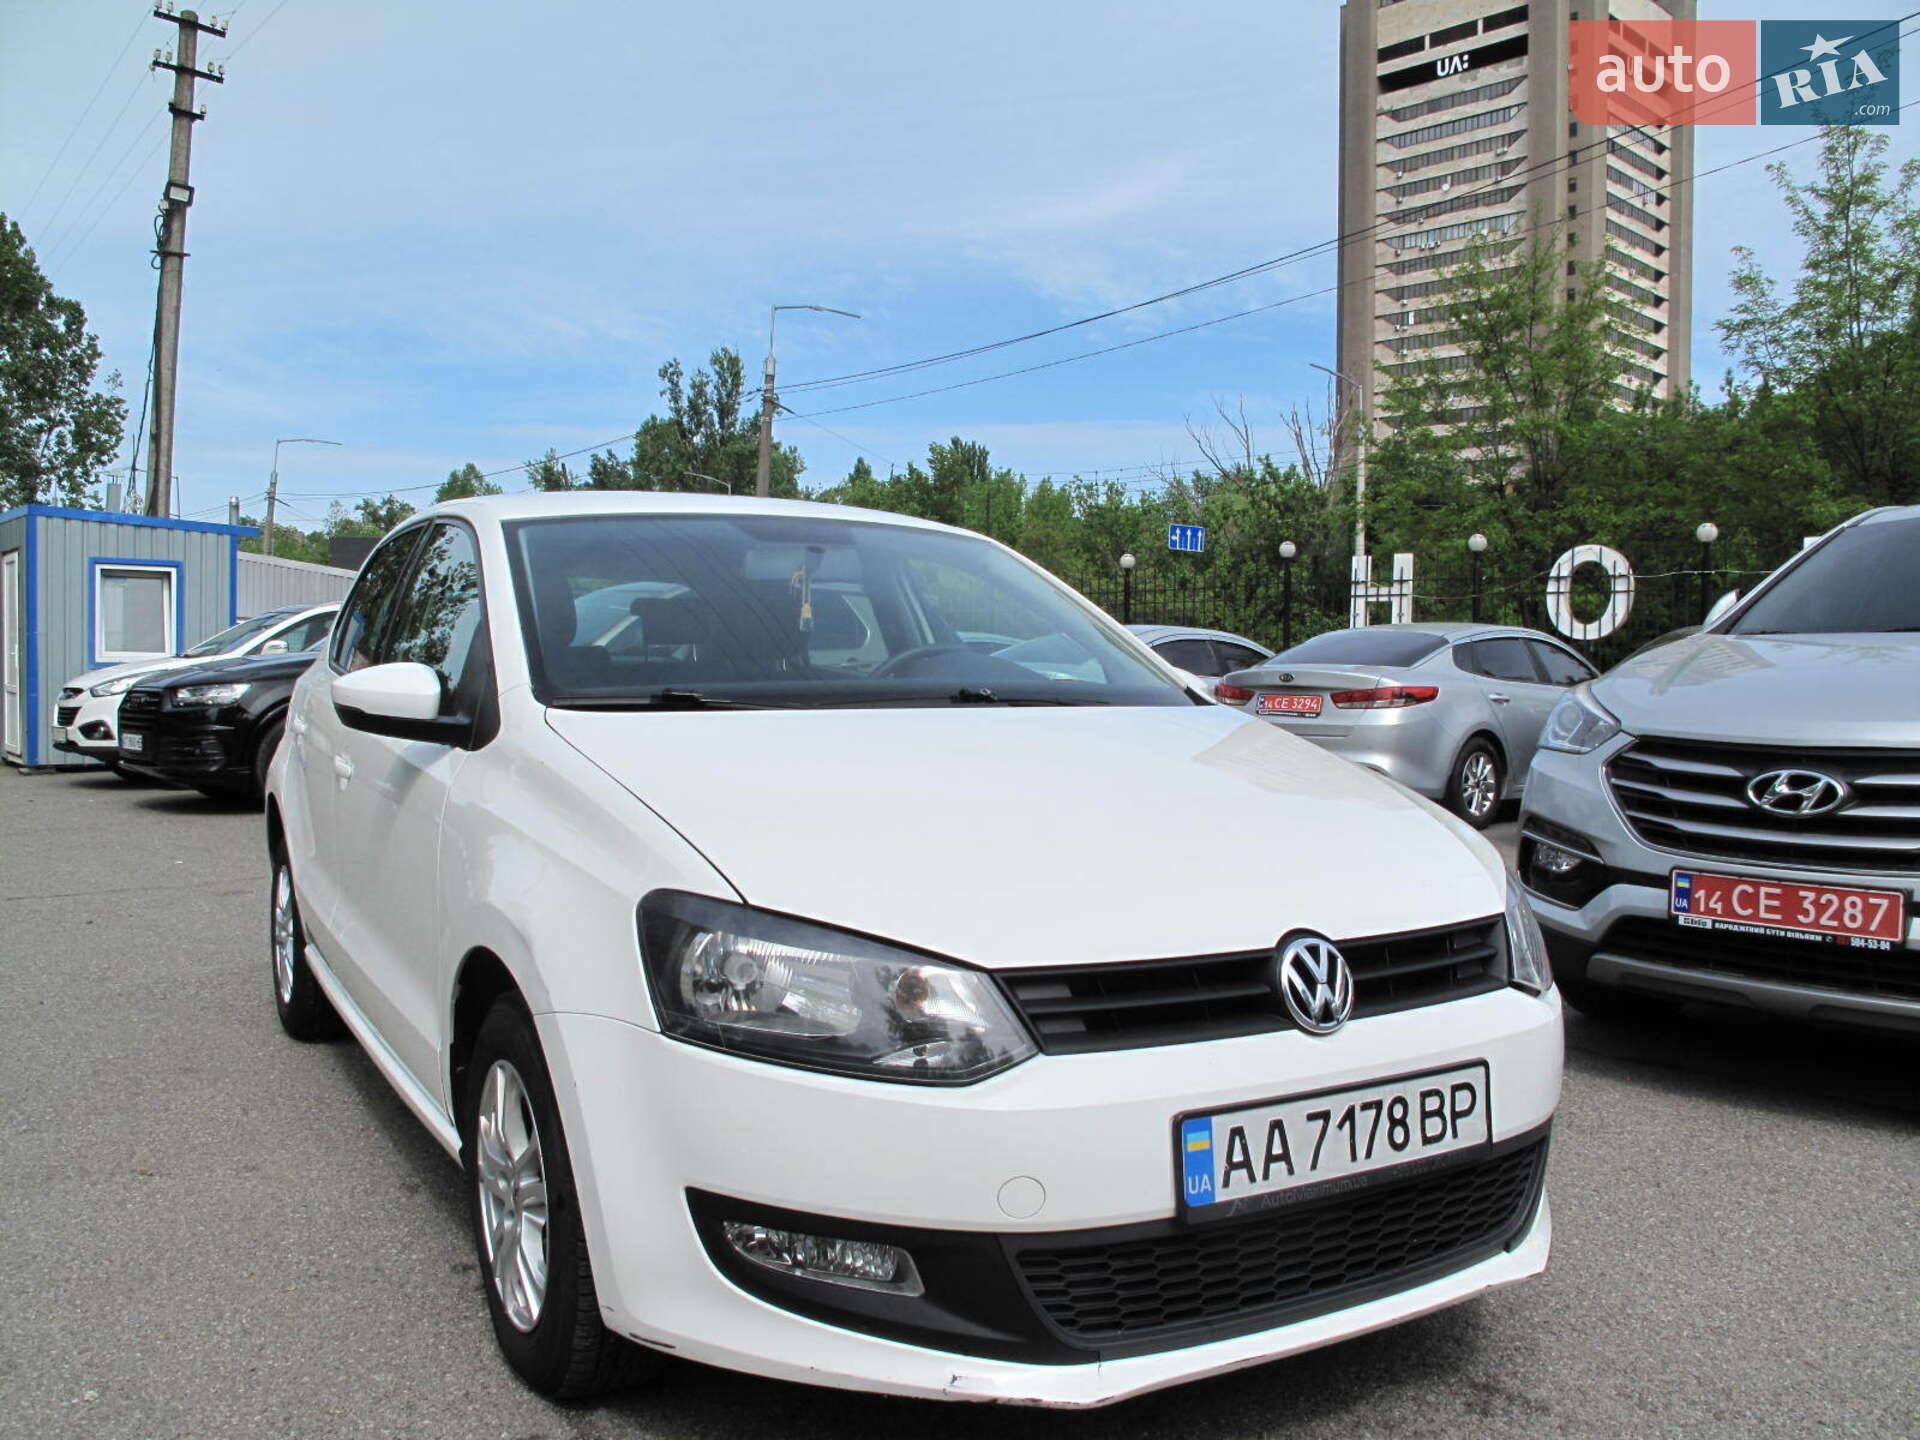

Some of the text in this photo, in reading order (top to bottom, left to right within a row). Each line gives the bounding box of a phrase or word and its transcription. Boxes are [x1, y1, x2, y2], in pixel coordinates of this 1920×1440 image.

[1675, 897, 1688, 909] UA
[1694, 884, 1890, 932] 14 CE 3287
[1188, 1174, 1212, 1195] UA
